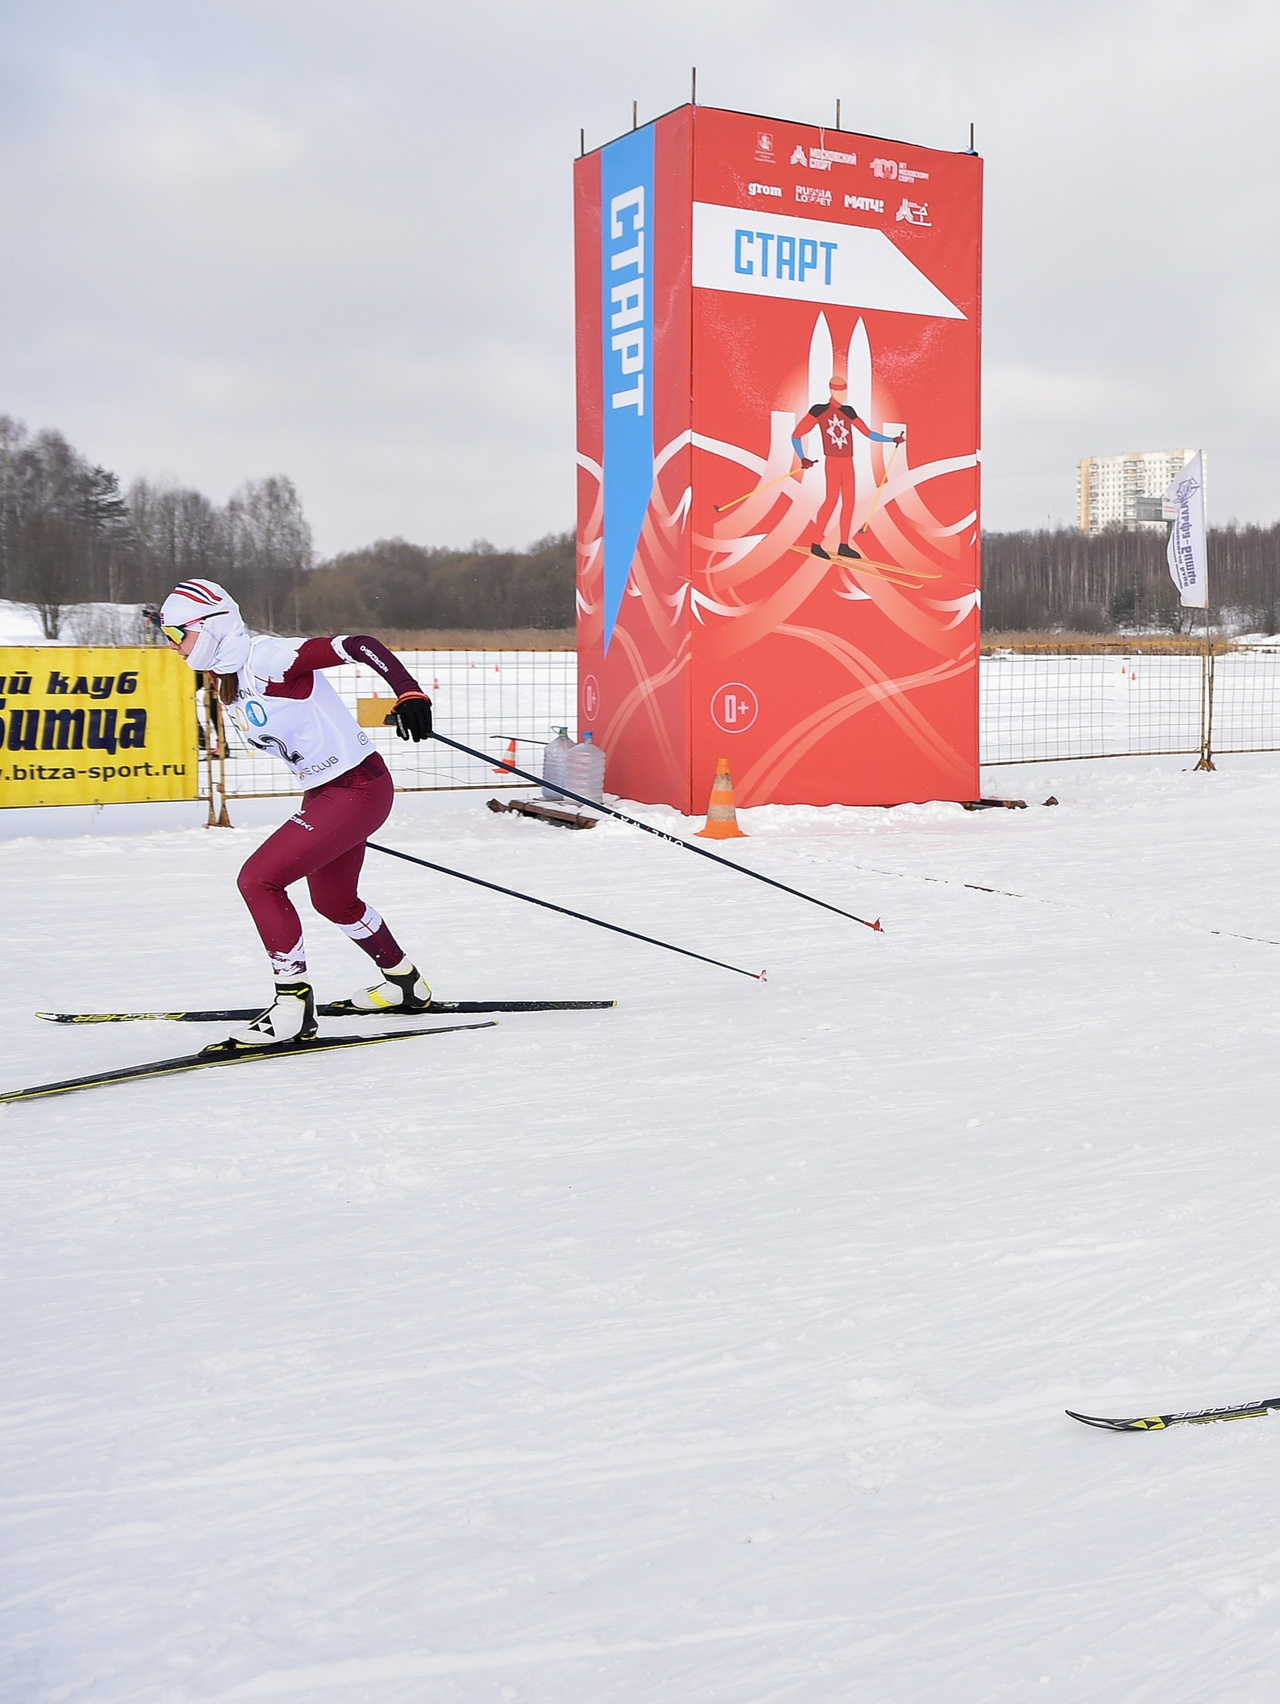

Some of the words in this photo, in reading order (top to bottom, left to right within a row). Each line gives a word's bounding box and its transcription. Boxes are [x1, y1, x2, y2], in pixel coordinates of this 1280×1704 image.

[795, 184, 832, 200] RUSSIA
[734, 228, 838, 286] СТАРТ
[610, 185, 645, 417] СТАРТ
[46, 671, 139, 699] клуб
[724, 694, 749, 723] 0+
[0, 762, 187, 782] .bitza-sport.ru
